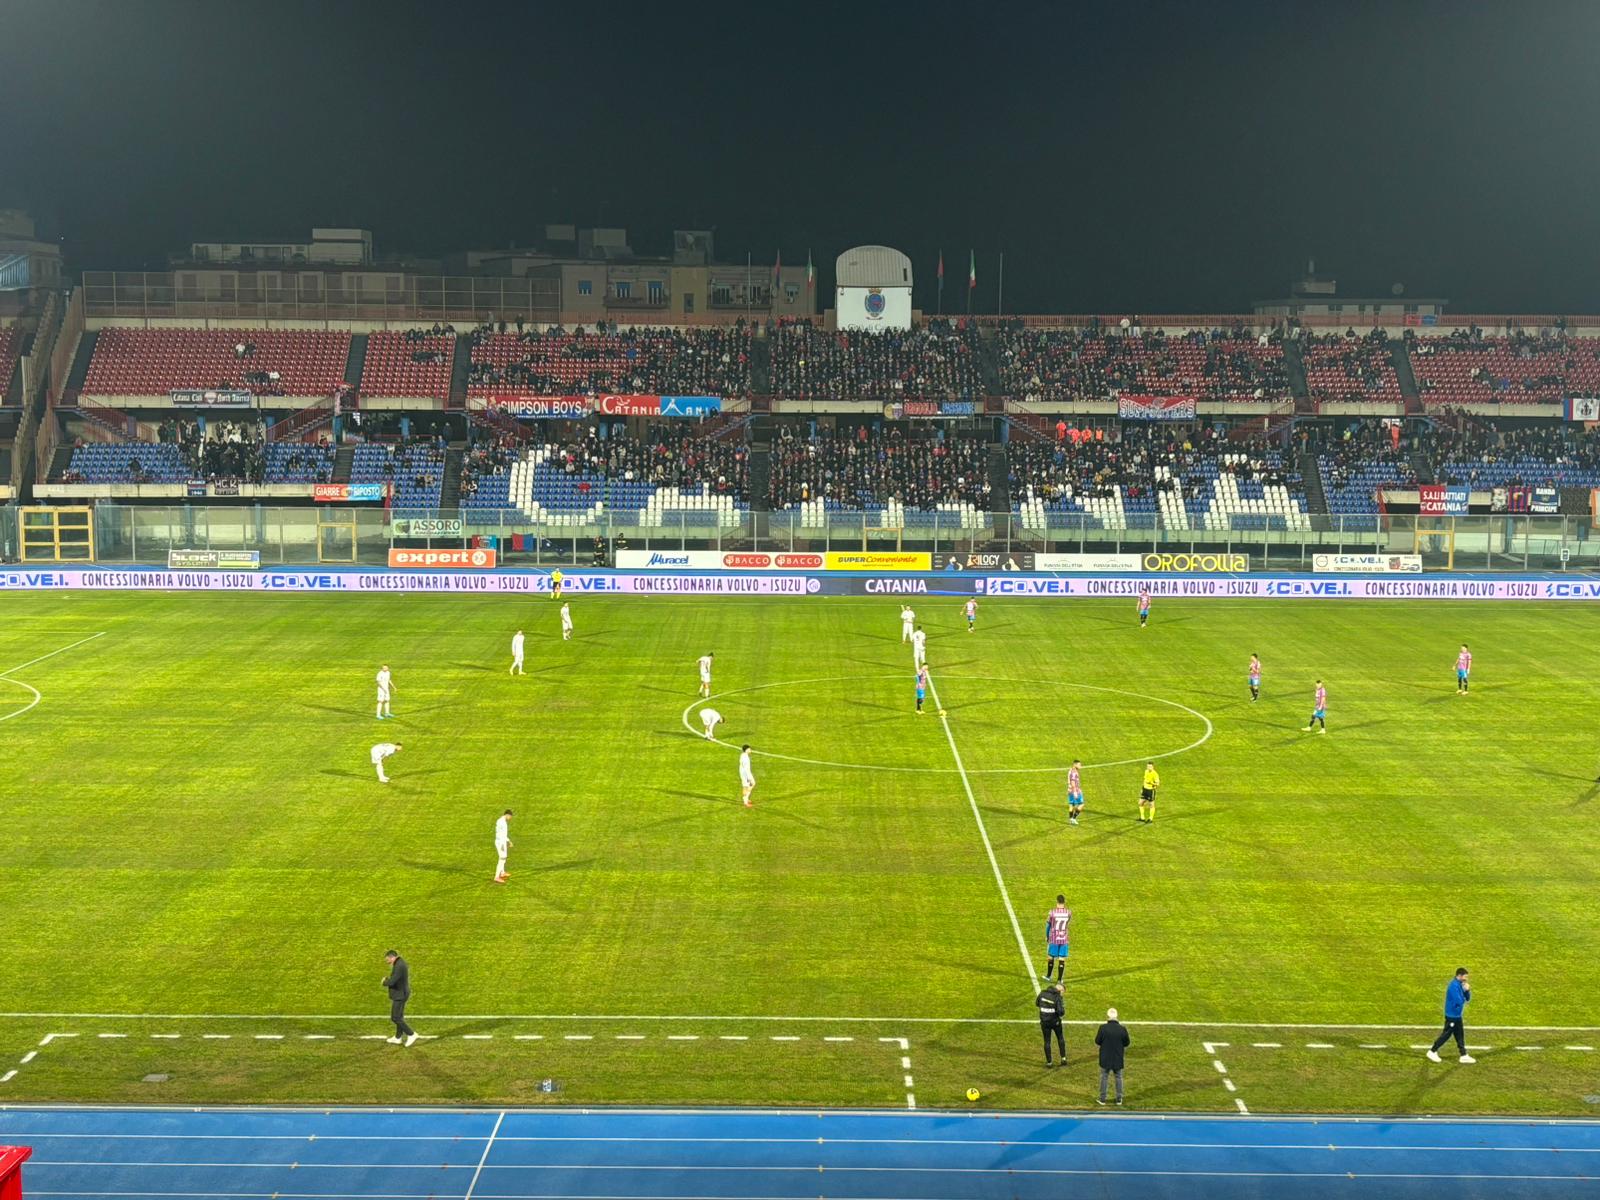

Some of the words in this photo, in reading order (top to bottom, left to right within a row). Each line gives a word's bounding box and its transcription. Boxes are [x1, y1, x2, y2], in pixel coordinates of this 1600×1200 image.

[500, 400, 549, 415] SIMPSON
[553, 401, 582, 414] BOYS
[602, 396, 661, 416] CATANIA
[316, 486, 340, 497] GIARRE
[353, 486, 380, 497] RIPOSTO
[1426, 502, 1461, 511] CATANIA
[413, 520, 460, 531] ASSORO
[396, 552, 468, 565] expert
[645, 552, 689, 567] Muracel
[735, 557, 769, 565] BACCO
[786, 557, 821, 565] BACCO
[967, 554, 1000, 567] TRILOGY
[82, 574, 174, 587] CONCESSIONARIA
[178, 574, 210, 587] VOLVO
[222, 575, 253, 588] ISUZU
[359, 576, 450, 588] CONCESSIONARIA
[454, 576, 487, 589] VOLVO
[498, 576, 529, 589] ISUZU
[633, 577, 723, 591] CONCESSIONARIA
[727, 578, 759, 591] VOLVO
[770, 578, 801, 592] ISUZU
[865, 579, 927, 592] CATANIA
[1087, 581, 1178, 594] CONCESSIONARIA
[1182, 581, 1215, 594] VOLVO
[1227, 581, 1258, 594] ISUZU
[1365, 583, 1457, 595] CONCESSIONARIA
[1462, 583, 1495, 595] VOLVO
[1506, 583, 1538, 596] ISUZU
[1055, 917, 1069, 930] 77
